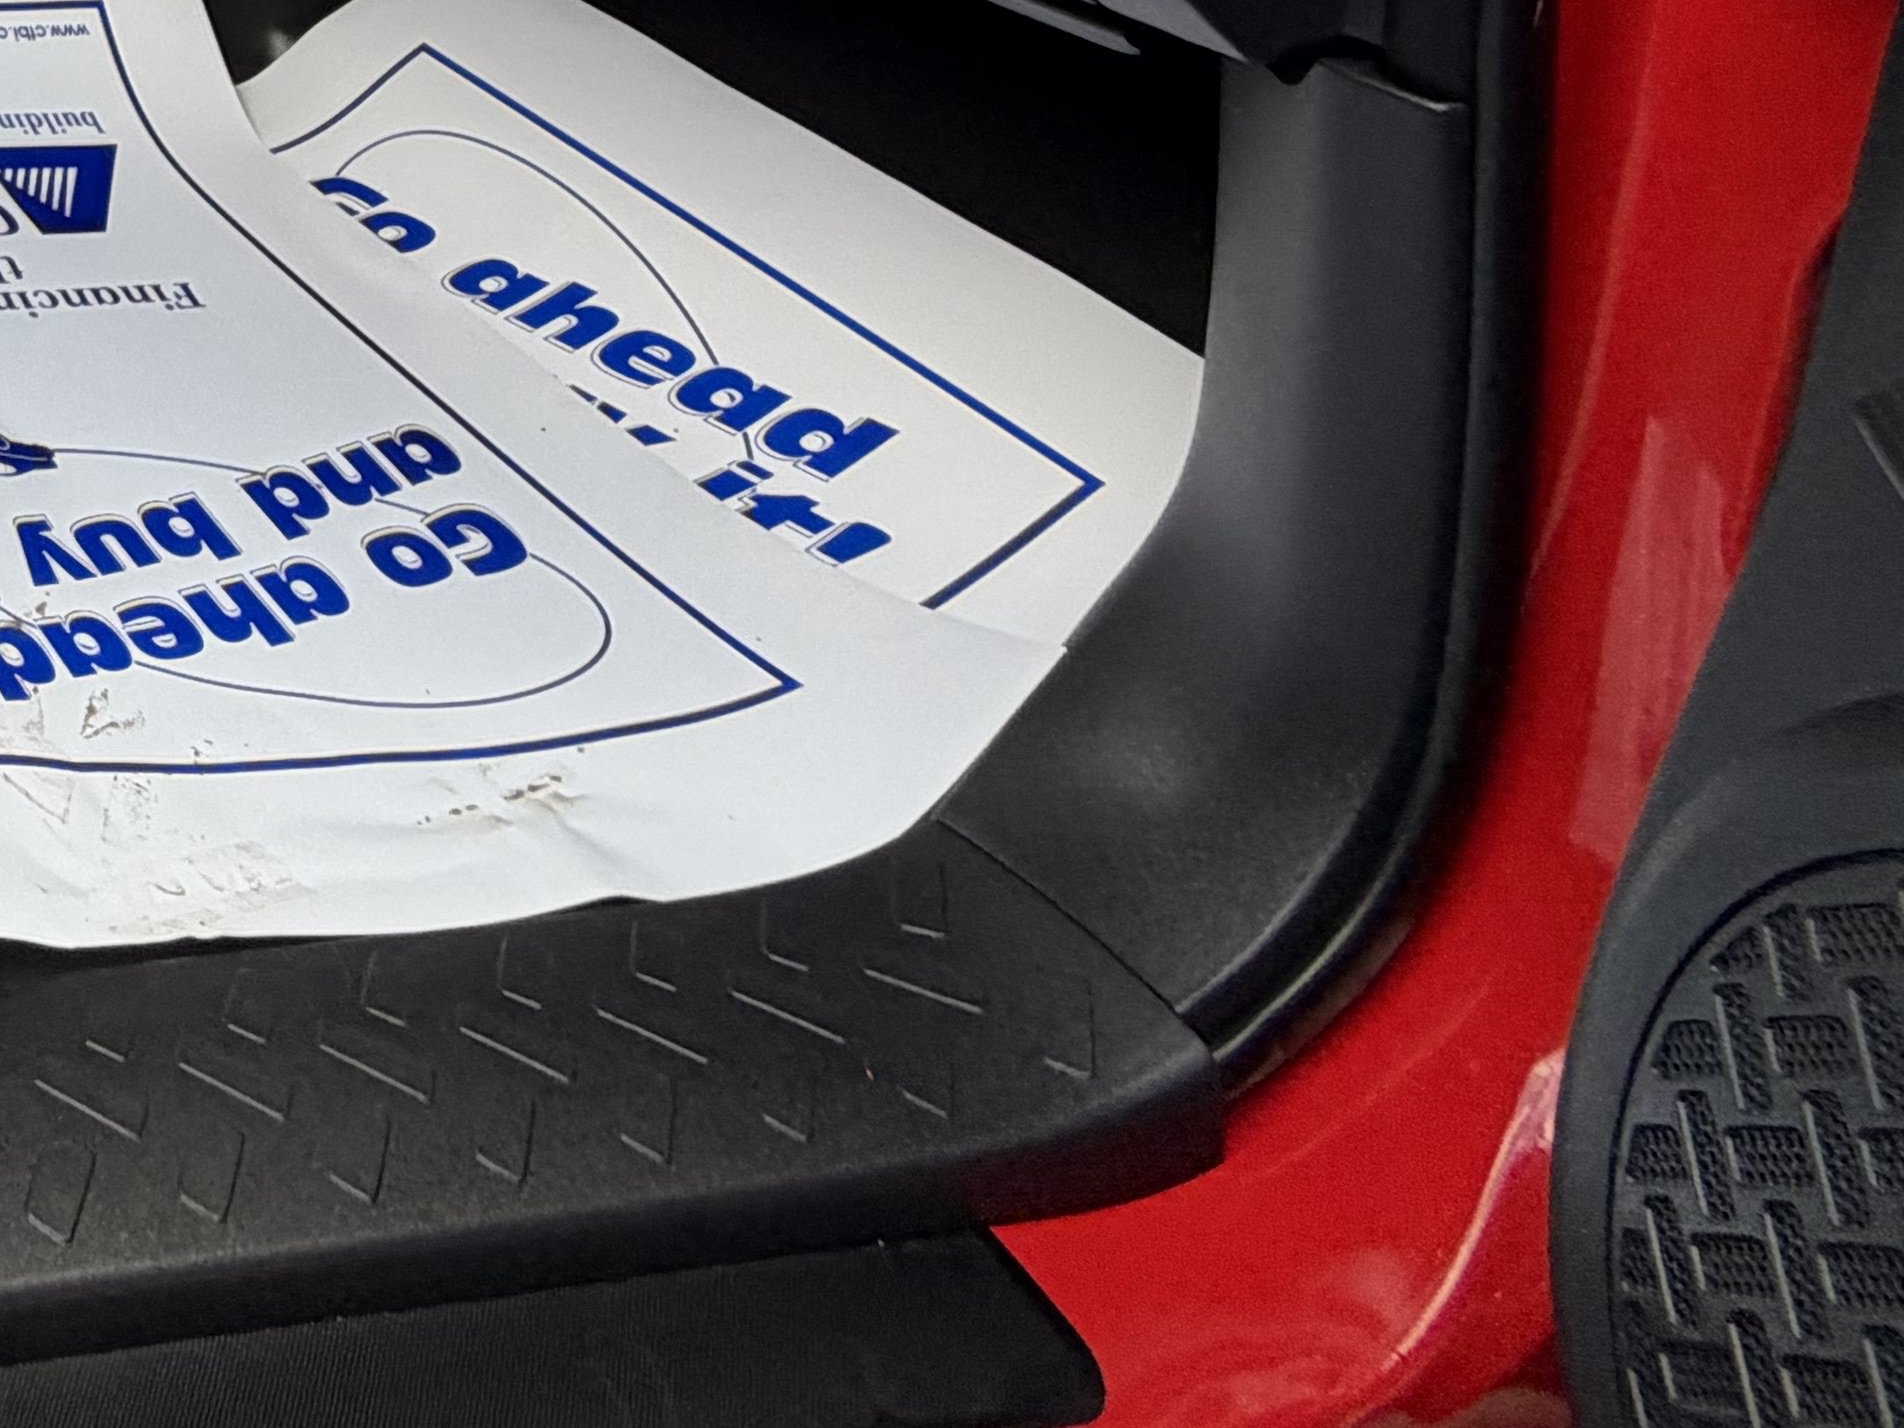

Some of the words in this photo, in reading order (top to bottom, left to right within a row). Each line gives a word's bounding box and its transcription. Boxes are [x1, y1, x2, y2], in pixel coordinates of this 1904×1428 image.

[441, 258, 902, 481] ahead
[236, 422, 462, 540] and
[12, 490, 243, 587] buy
[360, 501, 529, 588] Go
